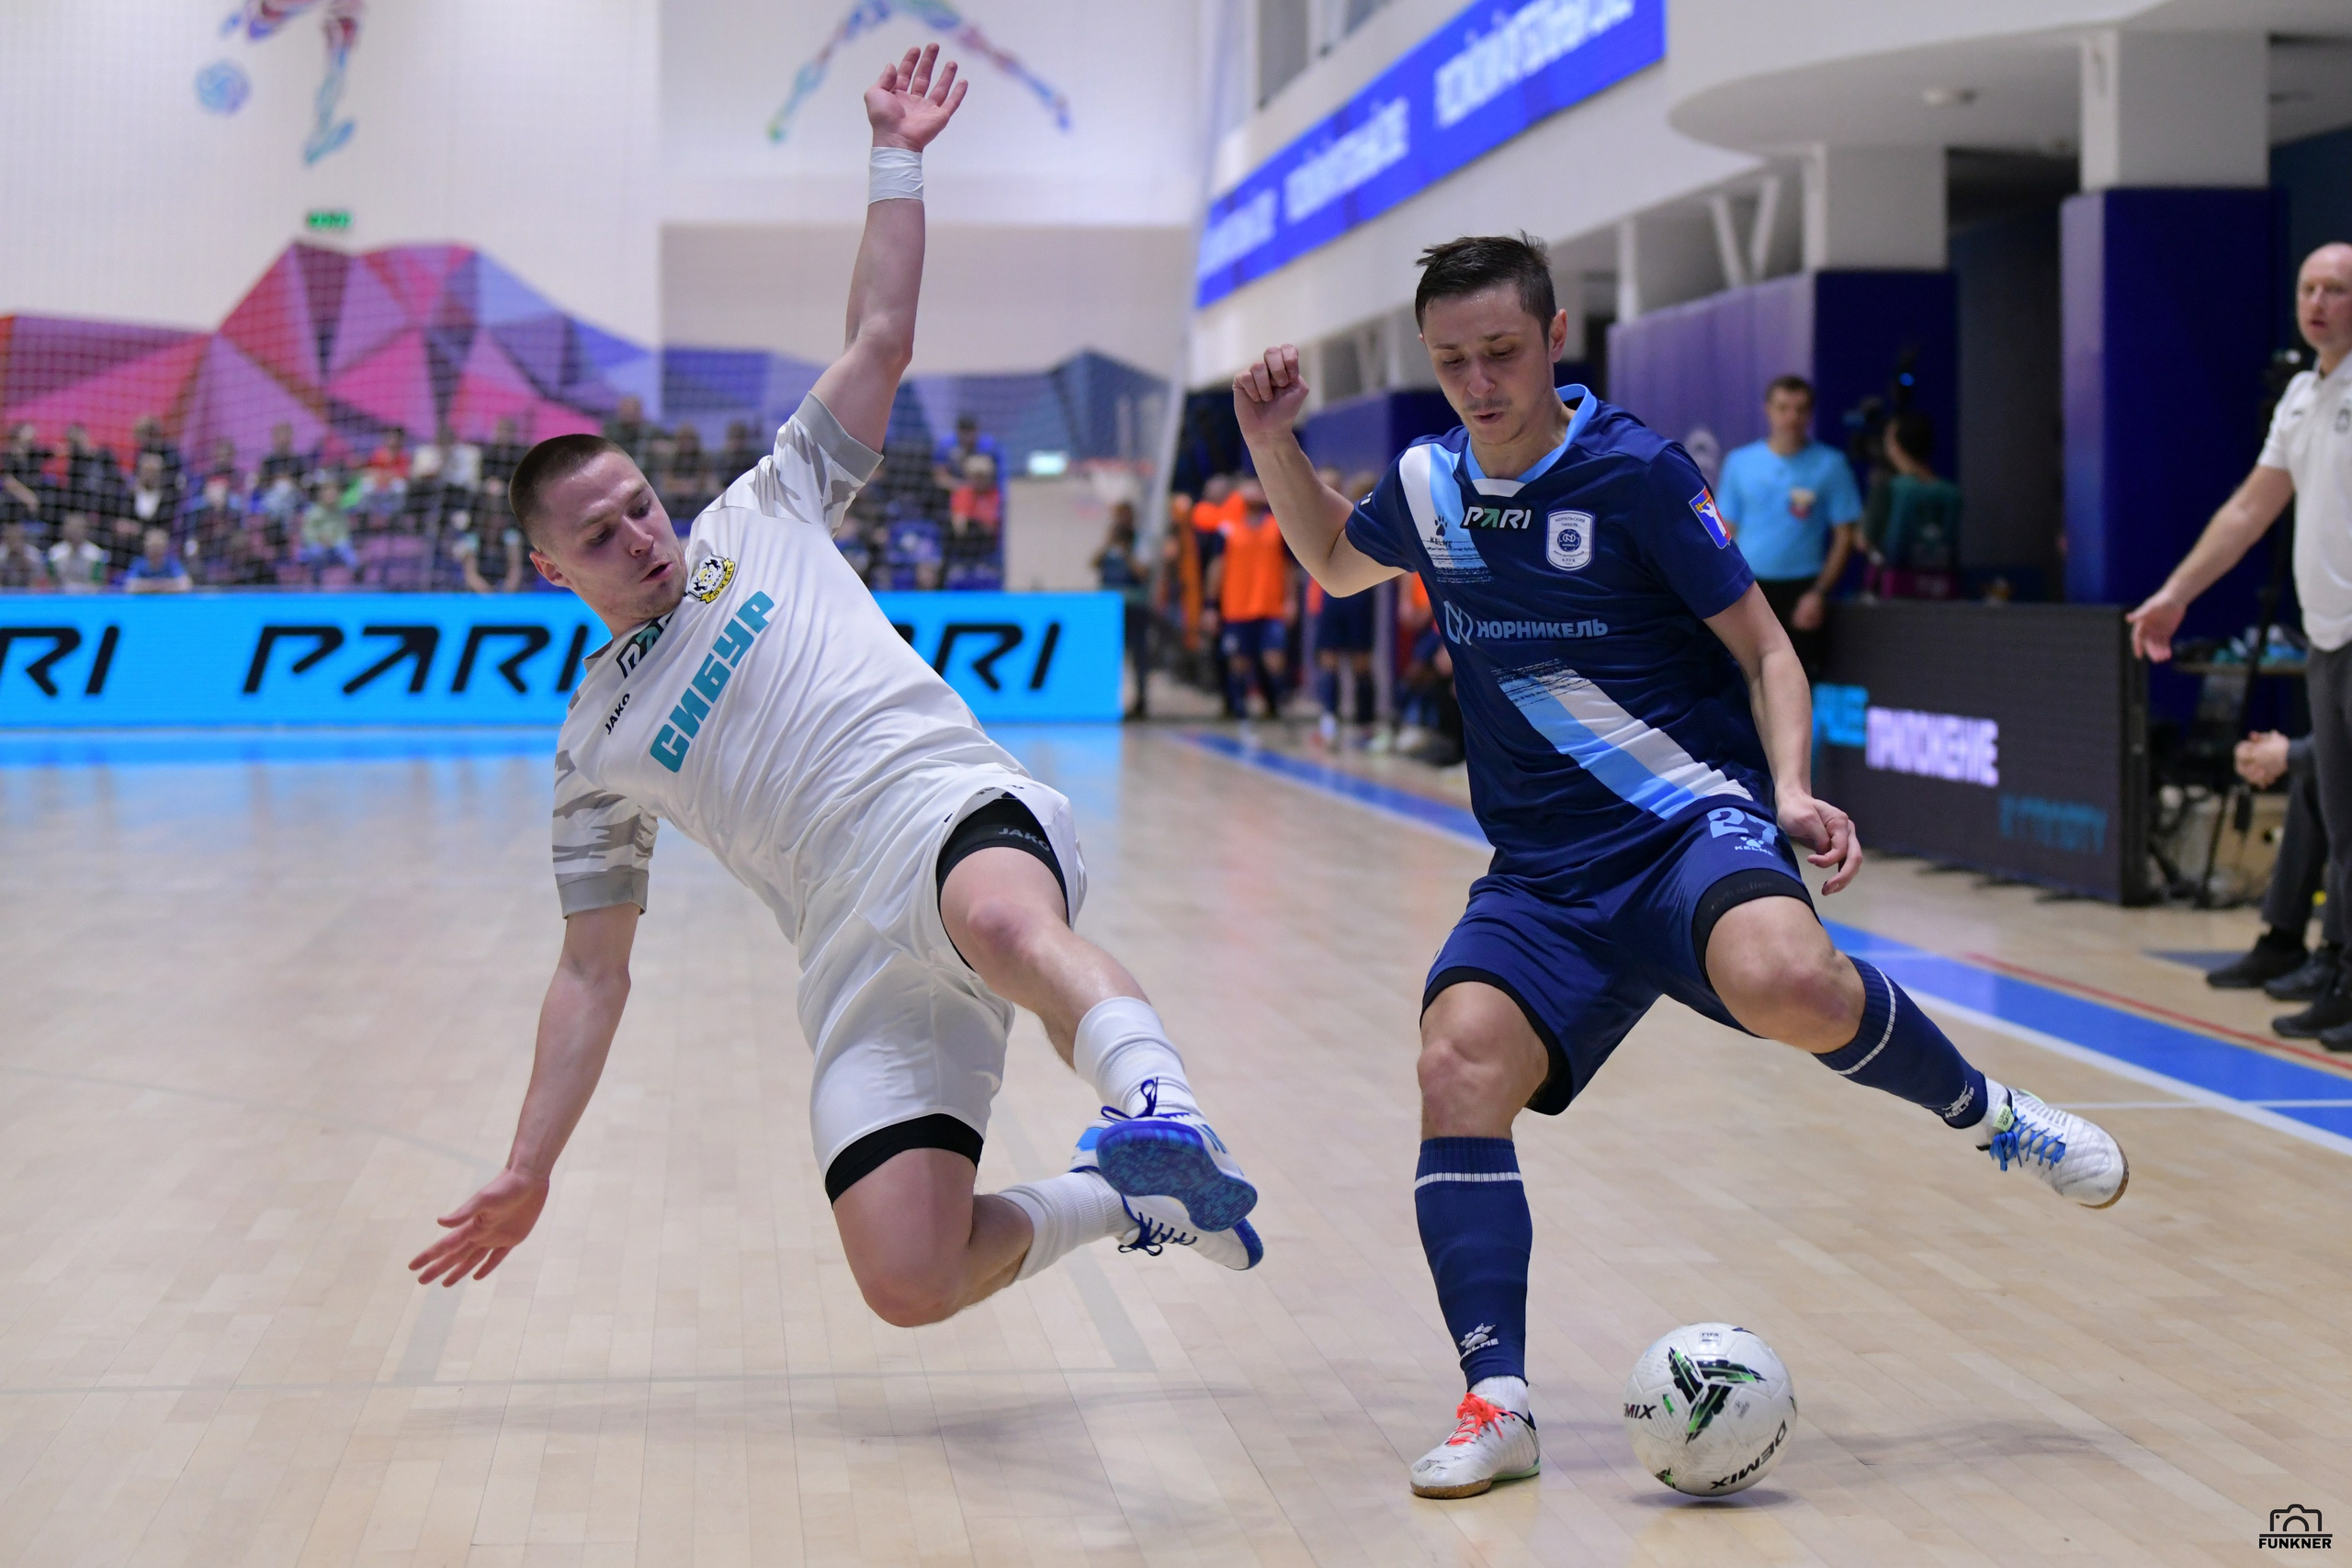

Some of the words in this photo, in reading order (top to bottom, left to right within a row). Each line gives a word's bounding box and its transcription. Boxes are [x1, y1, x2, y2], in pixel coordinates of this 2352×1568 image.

[1463, 506, 1532, 529] PARI
[1430, 536, 1453, 548] KELME
[1476, 618, 1608, 638] НОРНИКЕЛЬ
[243, 625, 588, 694] PARI
[650, 591, 775, 773] СИБУР
[605, 694, 630, 735] JAKO
[999, 828, 1051, 852] JAKO
[1707, 807, 1779, 845] 27
[1710, 1419, 1787, 1490] DEMIX
